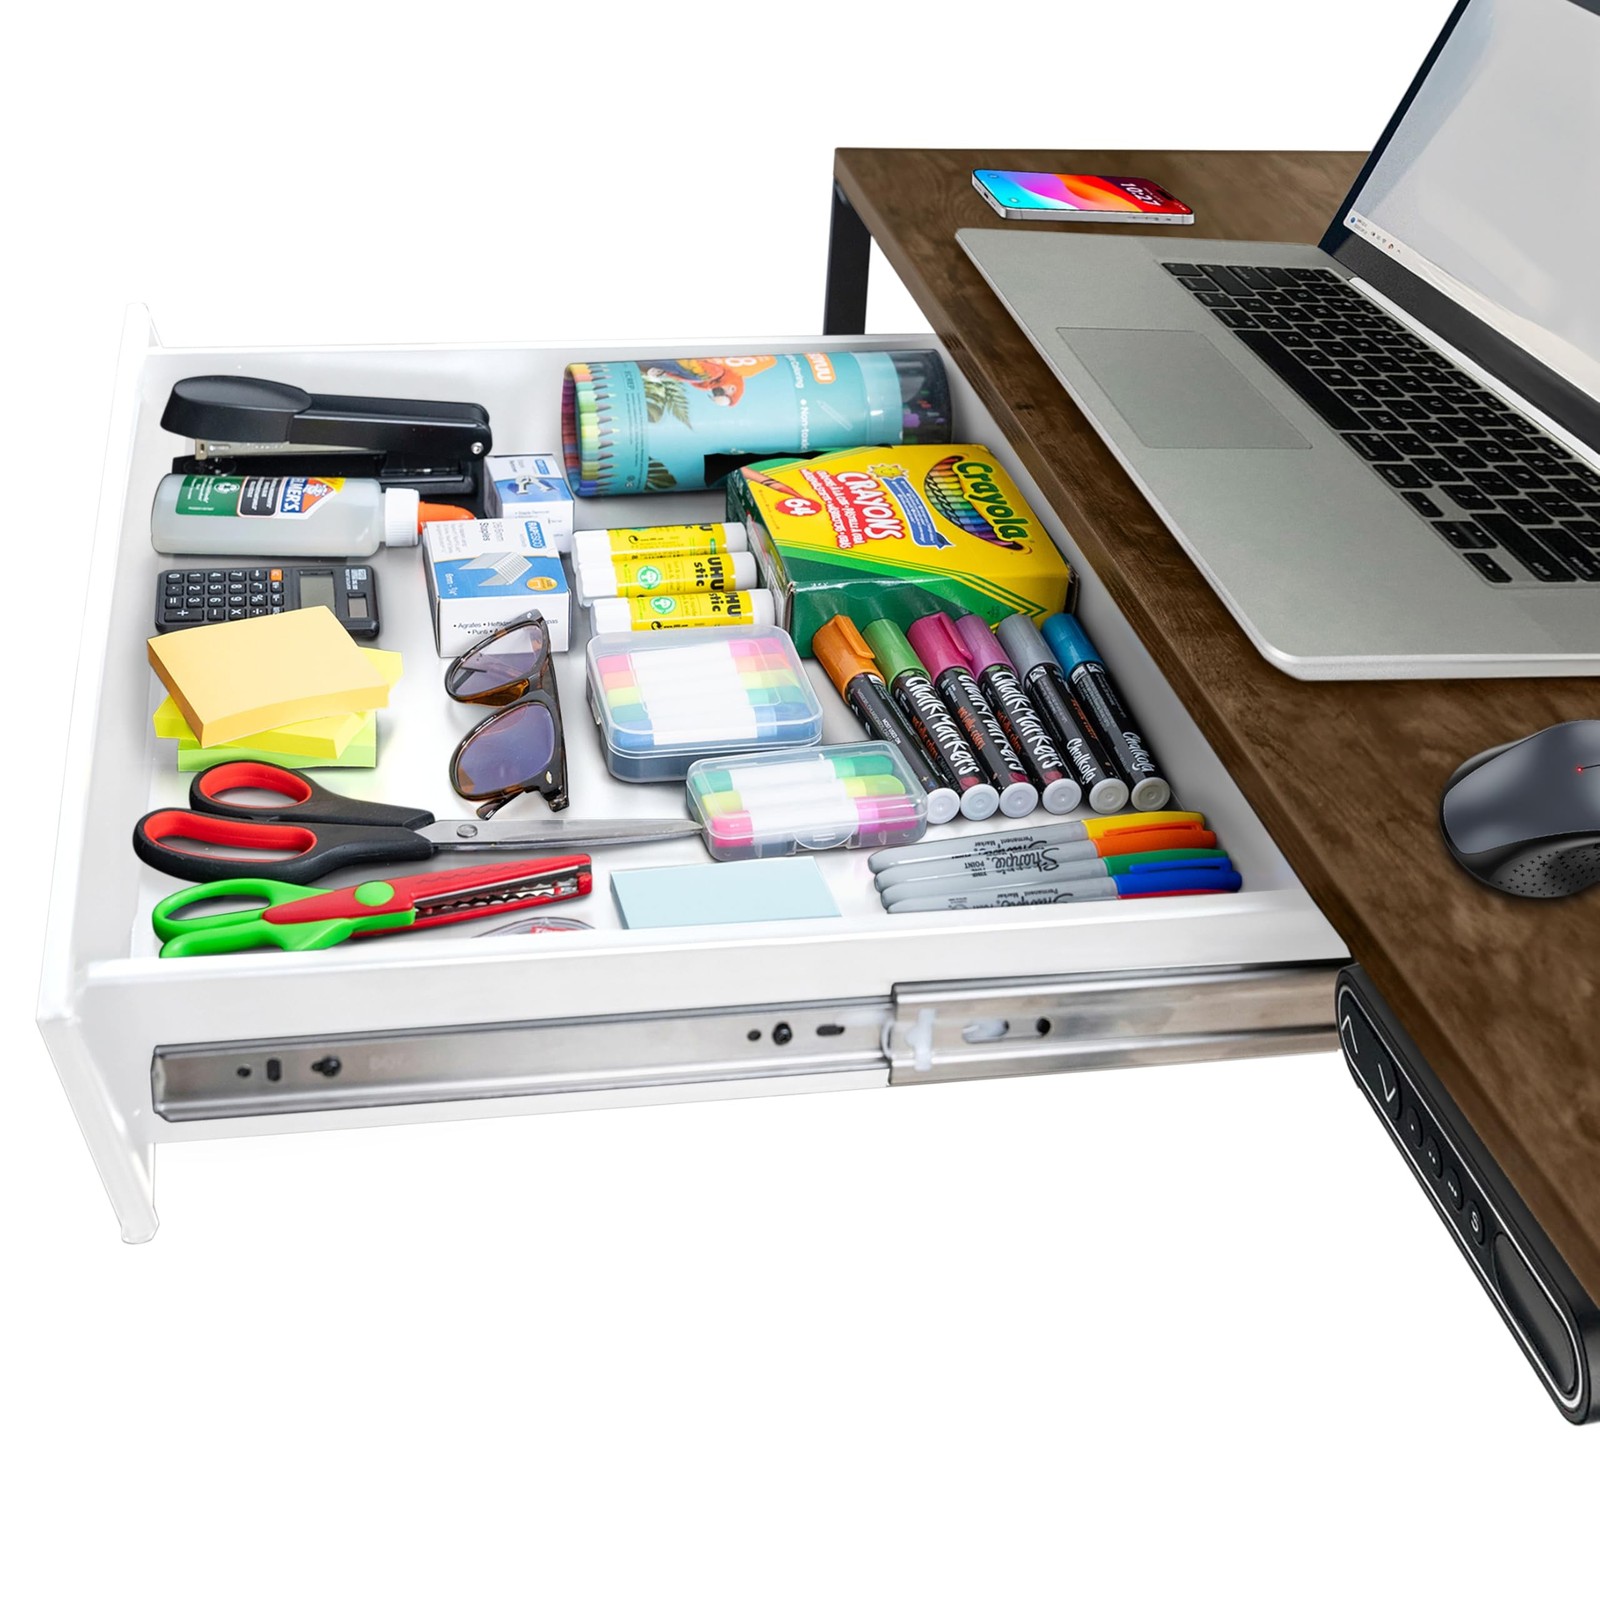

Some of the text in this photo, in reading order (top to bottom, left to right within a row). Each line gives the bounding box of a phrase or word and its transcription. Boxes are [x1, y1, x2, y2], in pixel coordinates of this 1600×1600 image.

[1120, 183, 1161, 206] 10:27
[784, 498, 818, 516] 64
[836, 472, 905, 540] CRAYONS
[956, 461, 1029, 539] Crayola
[480, 522, 490, 541] Staples
[694, 561, 708, 587] stic
[708, 556, 725, 590] UHU
[1066, 737, 1097, 785] Chalkola
[1122, 731, 1155, 772] Chalkola
[964, 860, 985, 870] POINT
[990, 848, 1060, 872] Sharpie
[1471, 1211, 1479, 1232] S
